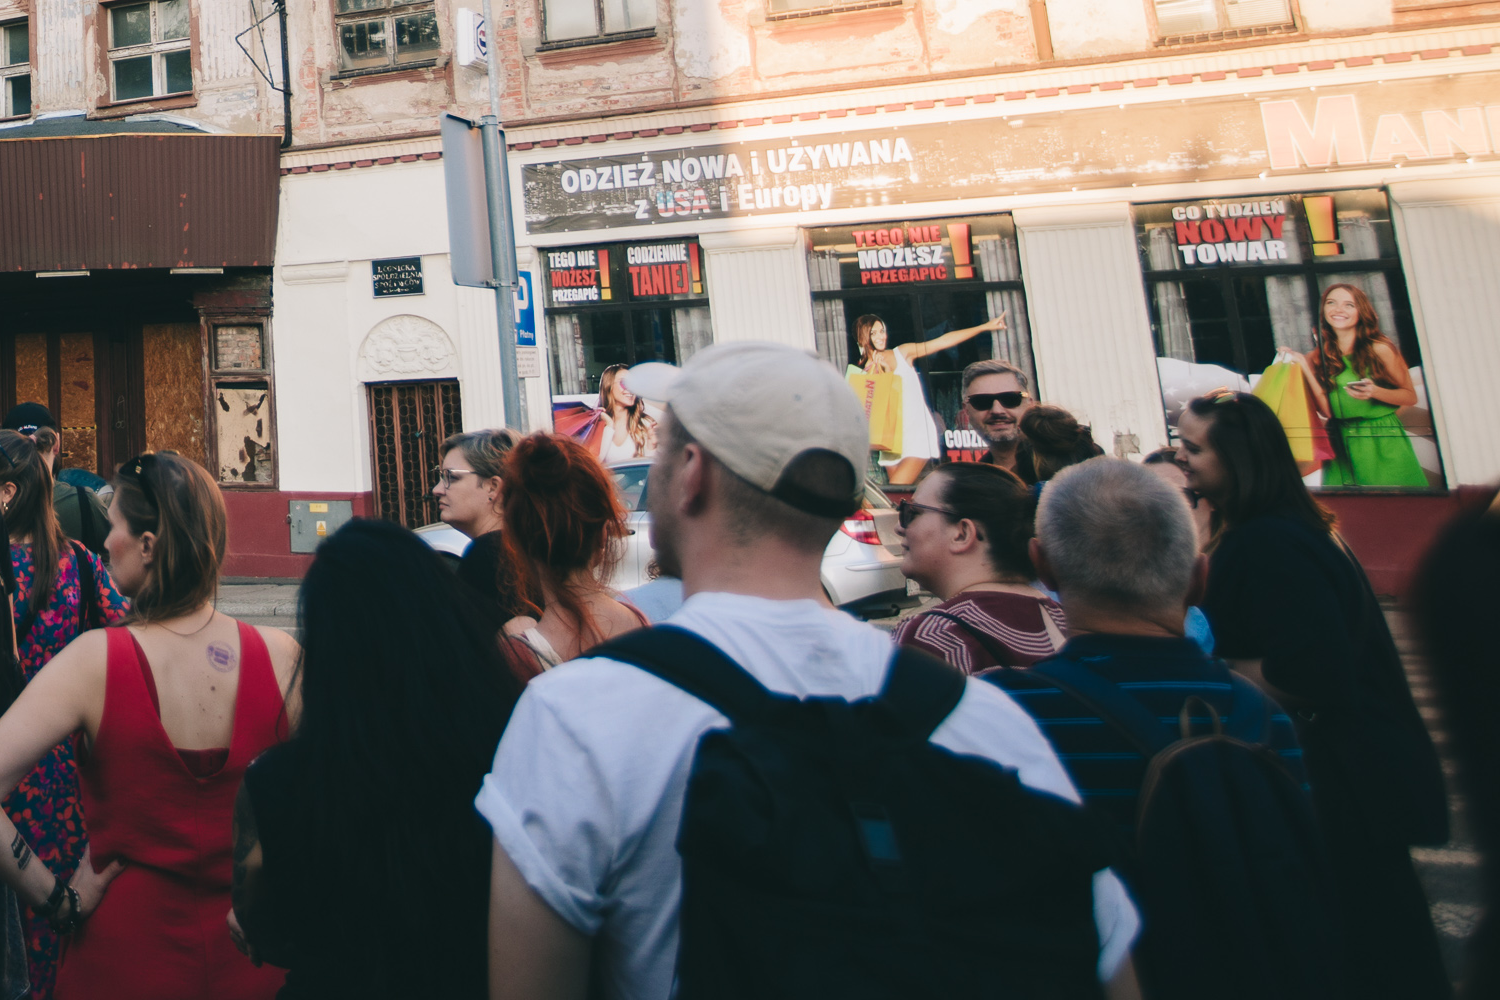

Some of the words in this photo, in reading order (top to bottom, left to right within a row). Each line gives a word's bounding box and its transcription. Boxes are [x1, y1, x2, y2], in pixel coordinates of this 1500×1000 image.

[1260, 94, 1500, 170] MAN
[561, 156, 656, 194] ODZIEŻ
[662, 153, 744, 184] NOWA
[750, 150, 761, 176] i
[766, 137, 913, 173] UŻYWANA
[634, 200, 650, 219] z
[657, 189, 710, 217] USA
[720, 186, 728, 212] i
[737, 182, 833, 211] Europy
[1172, 206, 1200, 220] CO
[1203, 198, 1285, 219] TYDZIEŃ
[852, 228, 904, 248] TEGO
[908, 225, 942, 243] NIE
[1174, 215, 1286, 245] NOWY
[1302, 196, 1343, 257] !
[547, 251, 576, 268] TEGO
[577, 250, 596, 266] NIE
[626, 243, 687, 265] CODZIENNIE
[857, 245, 945, 269] MOŻESZ
[947, 223, 973, 279] !
[1177, 240, 1288, 265] TOWAR
[551, 267, 597, 287] MOŻESZ
[597, 249, 612, 300] !
[628, 263, 689, 296] TANIEJ
[688, 243, 703, 294] !
[860, 265, 948, 285] PRZEGAPIĆ
[552, 286, 599, 302] PRZEGAPIĆ
